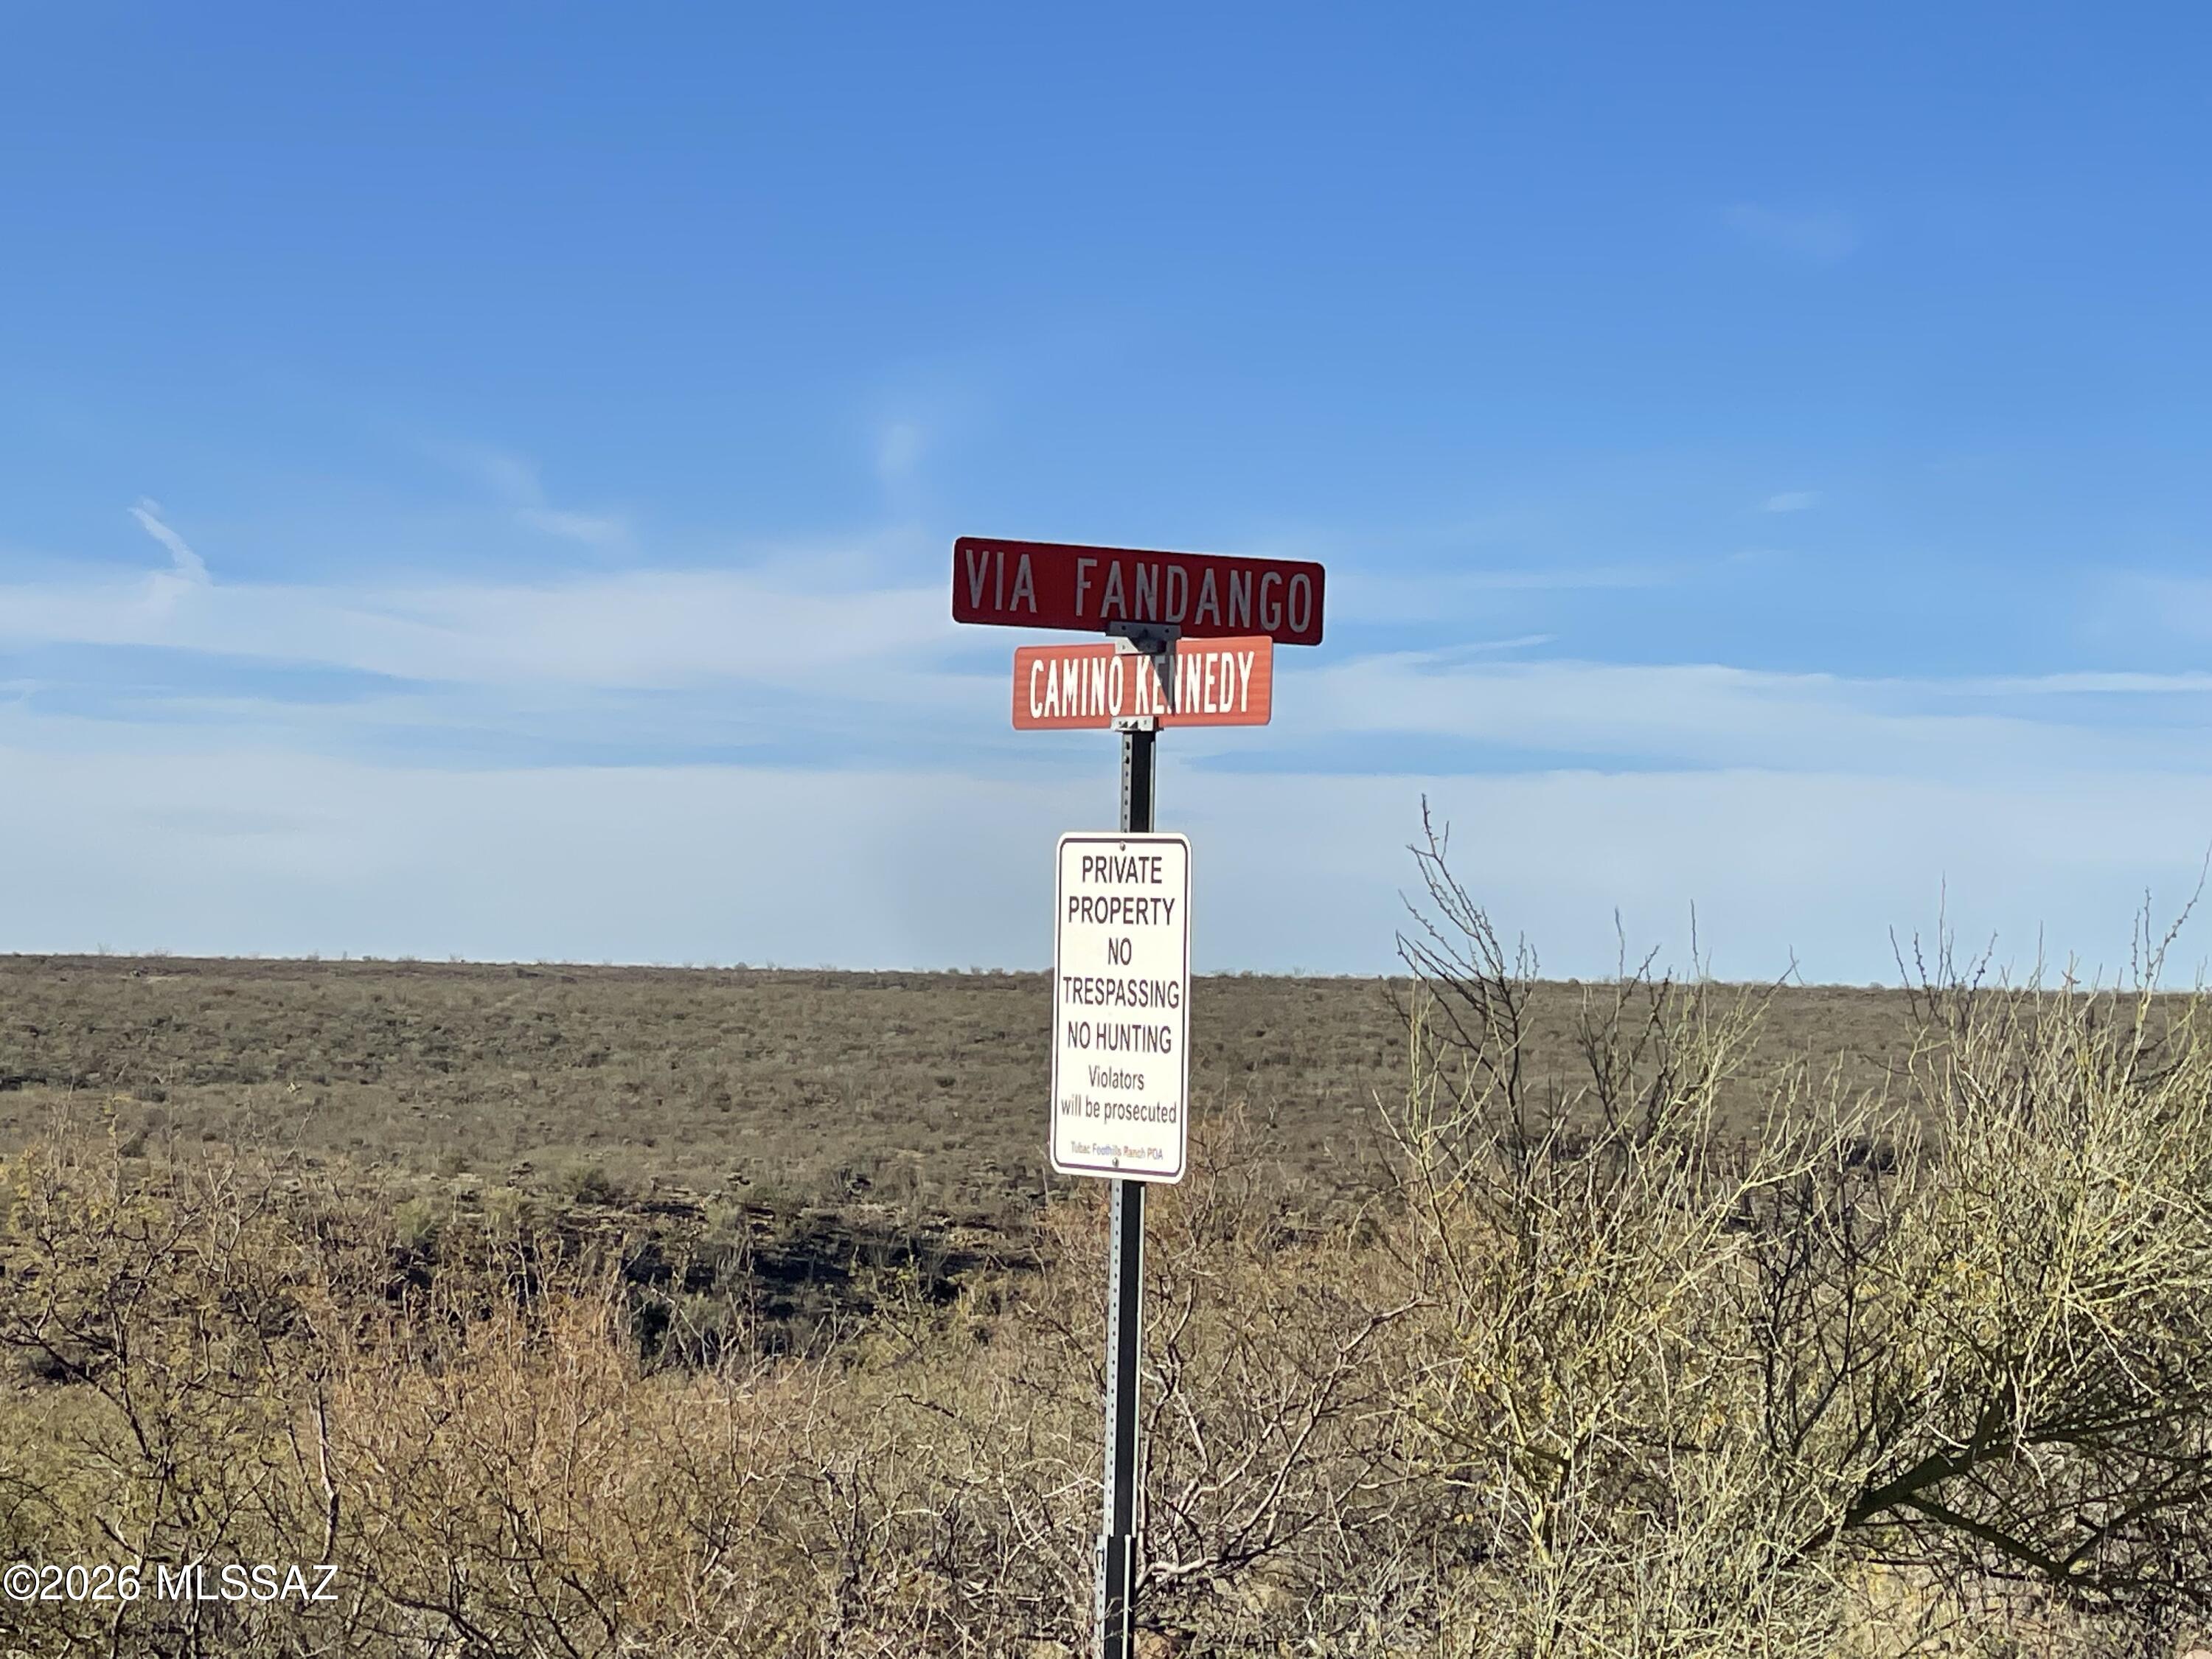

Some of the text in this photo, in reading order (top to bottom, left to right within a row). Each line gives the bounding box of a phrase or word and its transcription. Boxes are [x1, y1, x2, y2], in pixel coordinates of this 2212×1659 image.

[965, 549, 1312, 633] VIA FANDANGO
[1030, 651, 1255, 719] CAMINO KENNEDY
[1082, 855, 1163, 884] PRIVATE
[1068, 896, 1175, 925] PROPERTY
[1107, 937, 1132, 965] NO
[1062, 976, 1180, 1009] TRESPASSING
[1068, 1020, 1172, 1054] NO HUNTING
[1088, 1065, 1144, 1091] Violators
[1061, 1093, 1177, 1125] will be prosecuted
